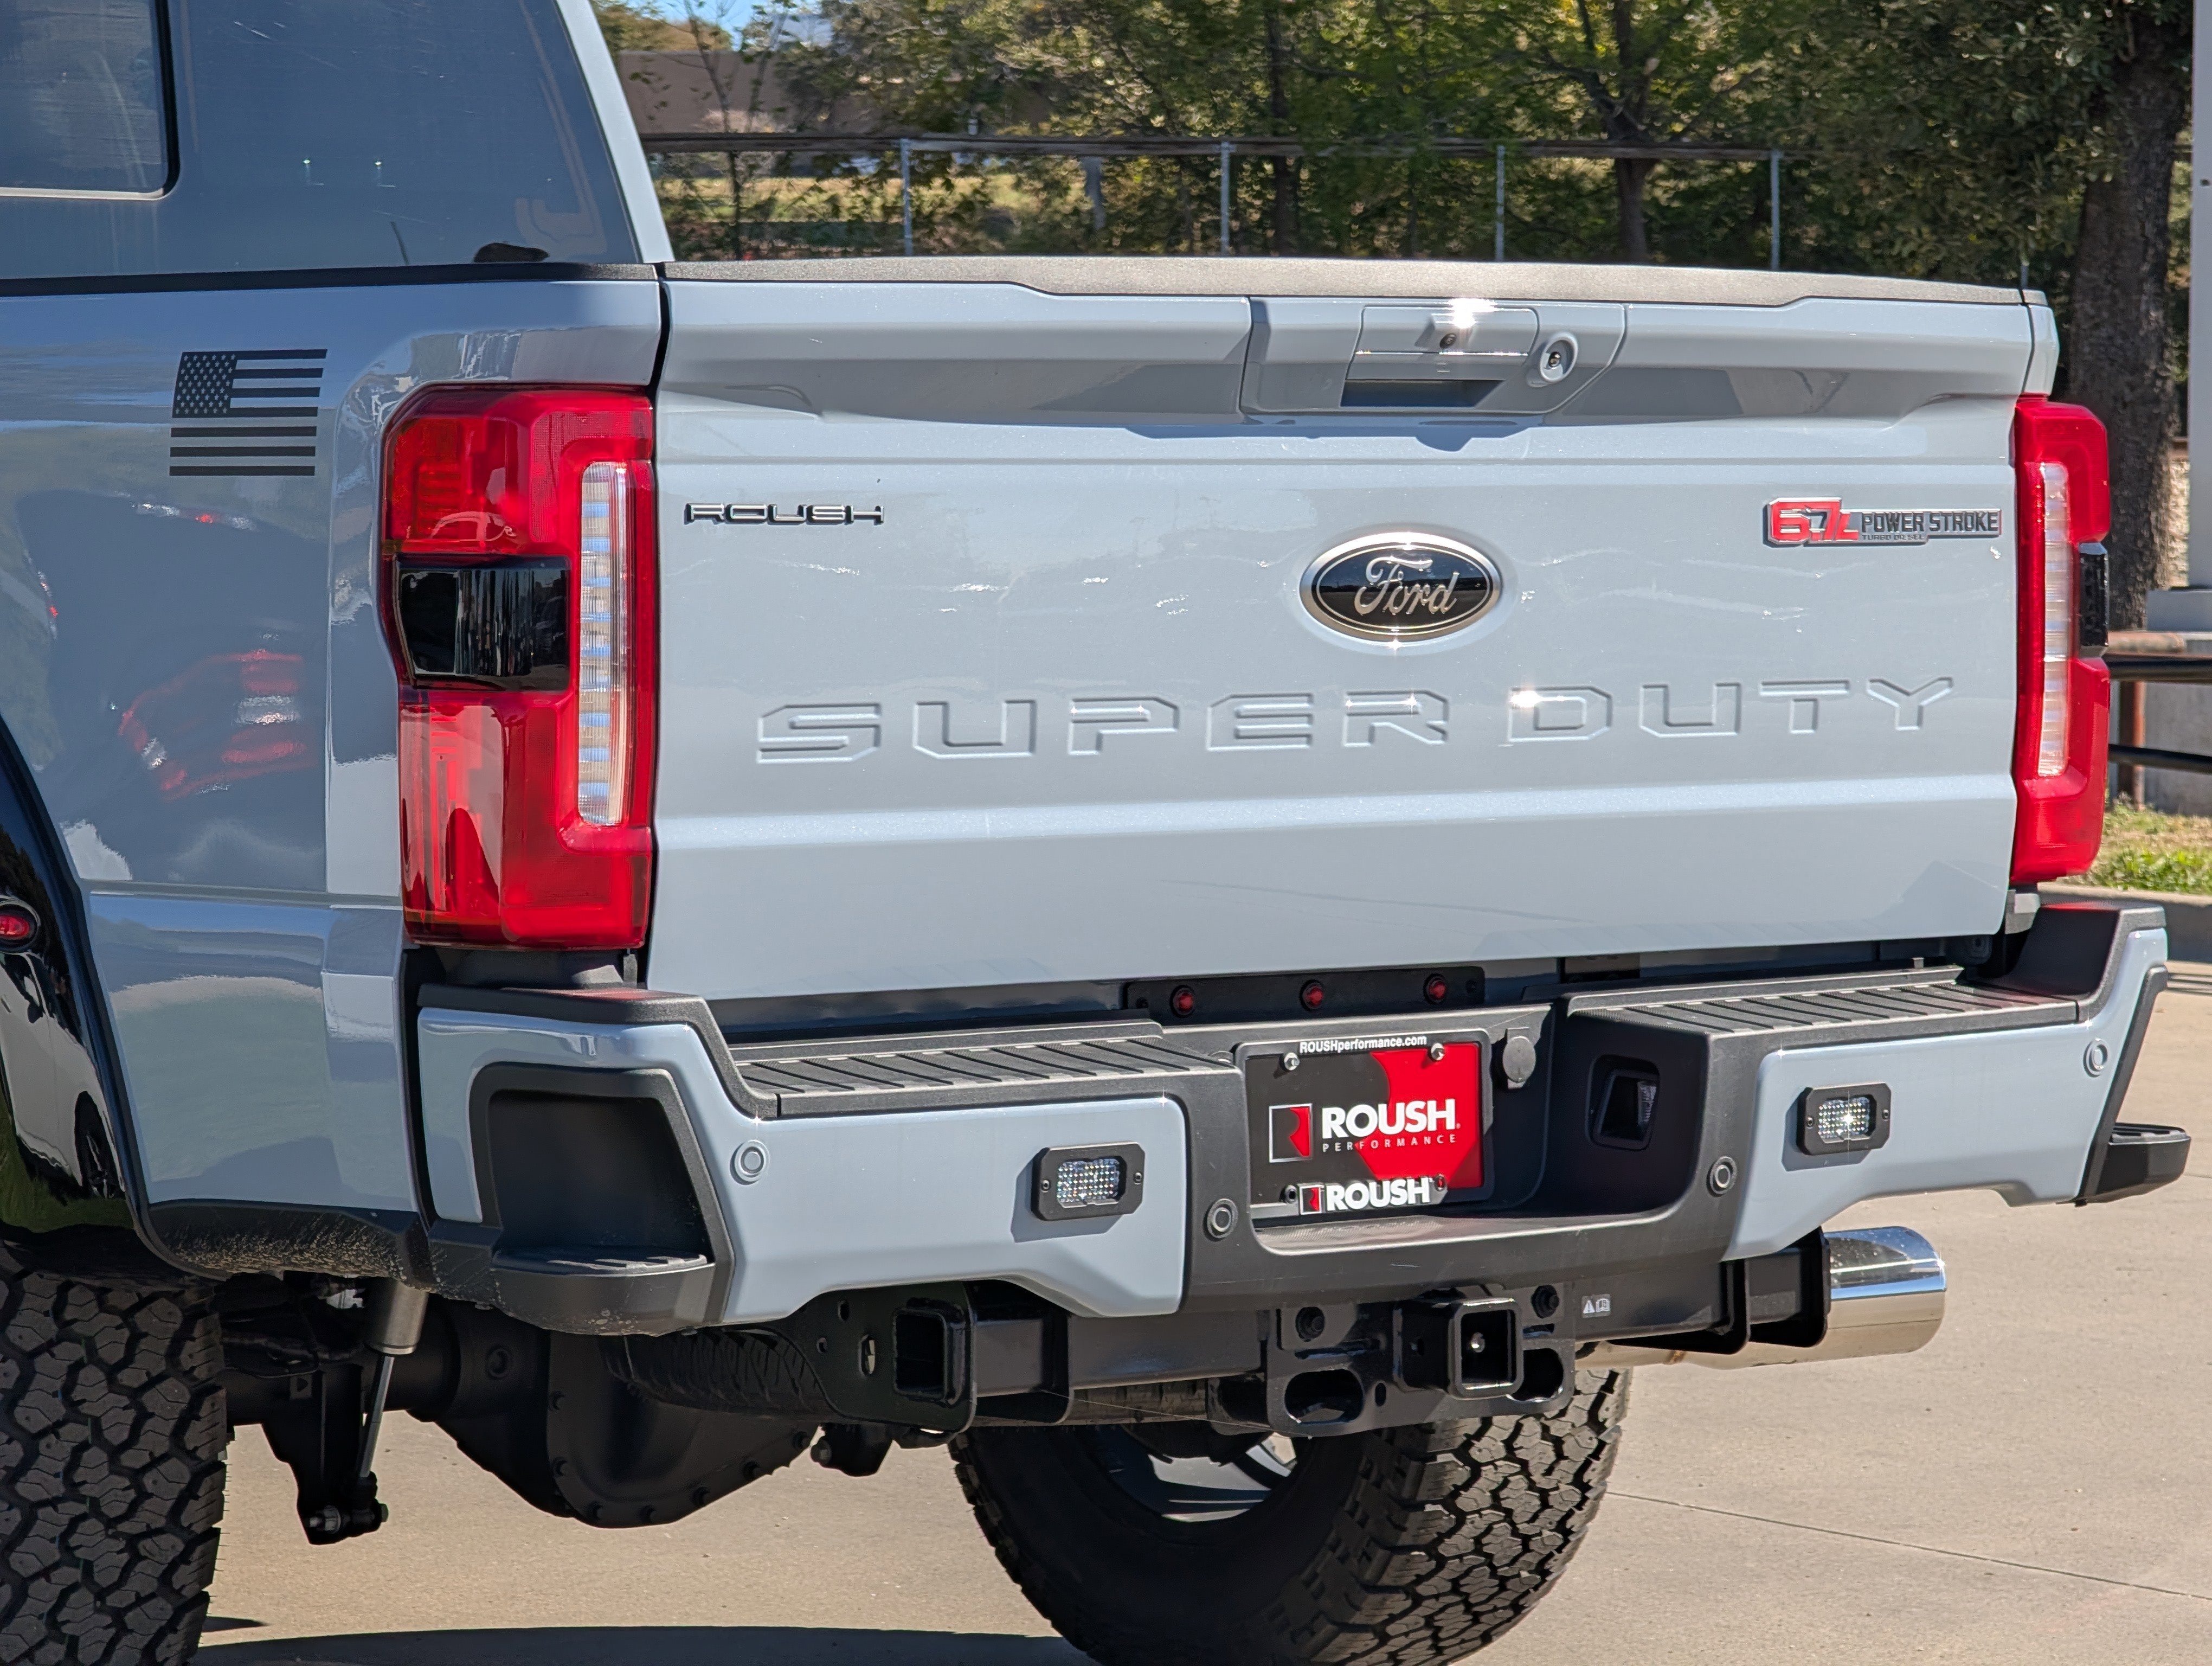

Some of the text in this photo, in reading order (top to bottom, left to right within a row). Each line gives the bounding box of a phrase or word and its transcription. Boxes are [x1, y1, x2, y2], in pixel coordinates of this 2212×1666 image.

[684, 503, 885, 525] ROUSH
[1861, 511, 1925, 533] POWER
[1930, 511, 1999, 532] STROKE
[1354, 556, 1459, 616] Ford
[757, 677, 1953, 764] SUPER DUTY
[1300, 1035, 1427, 1054] ROUSHperformance.com
[1322, 1133, 1457, 1152] PERFORMANCE
[1326, 1176, 1431, 1212] ROUSH
